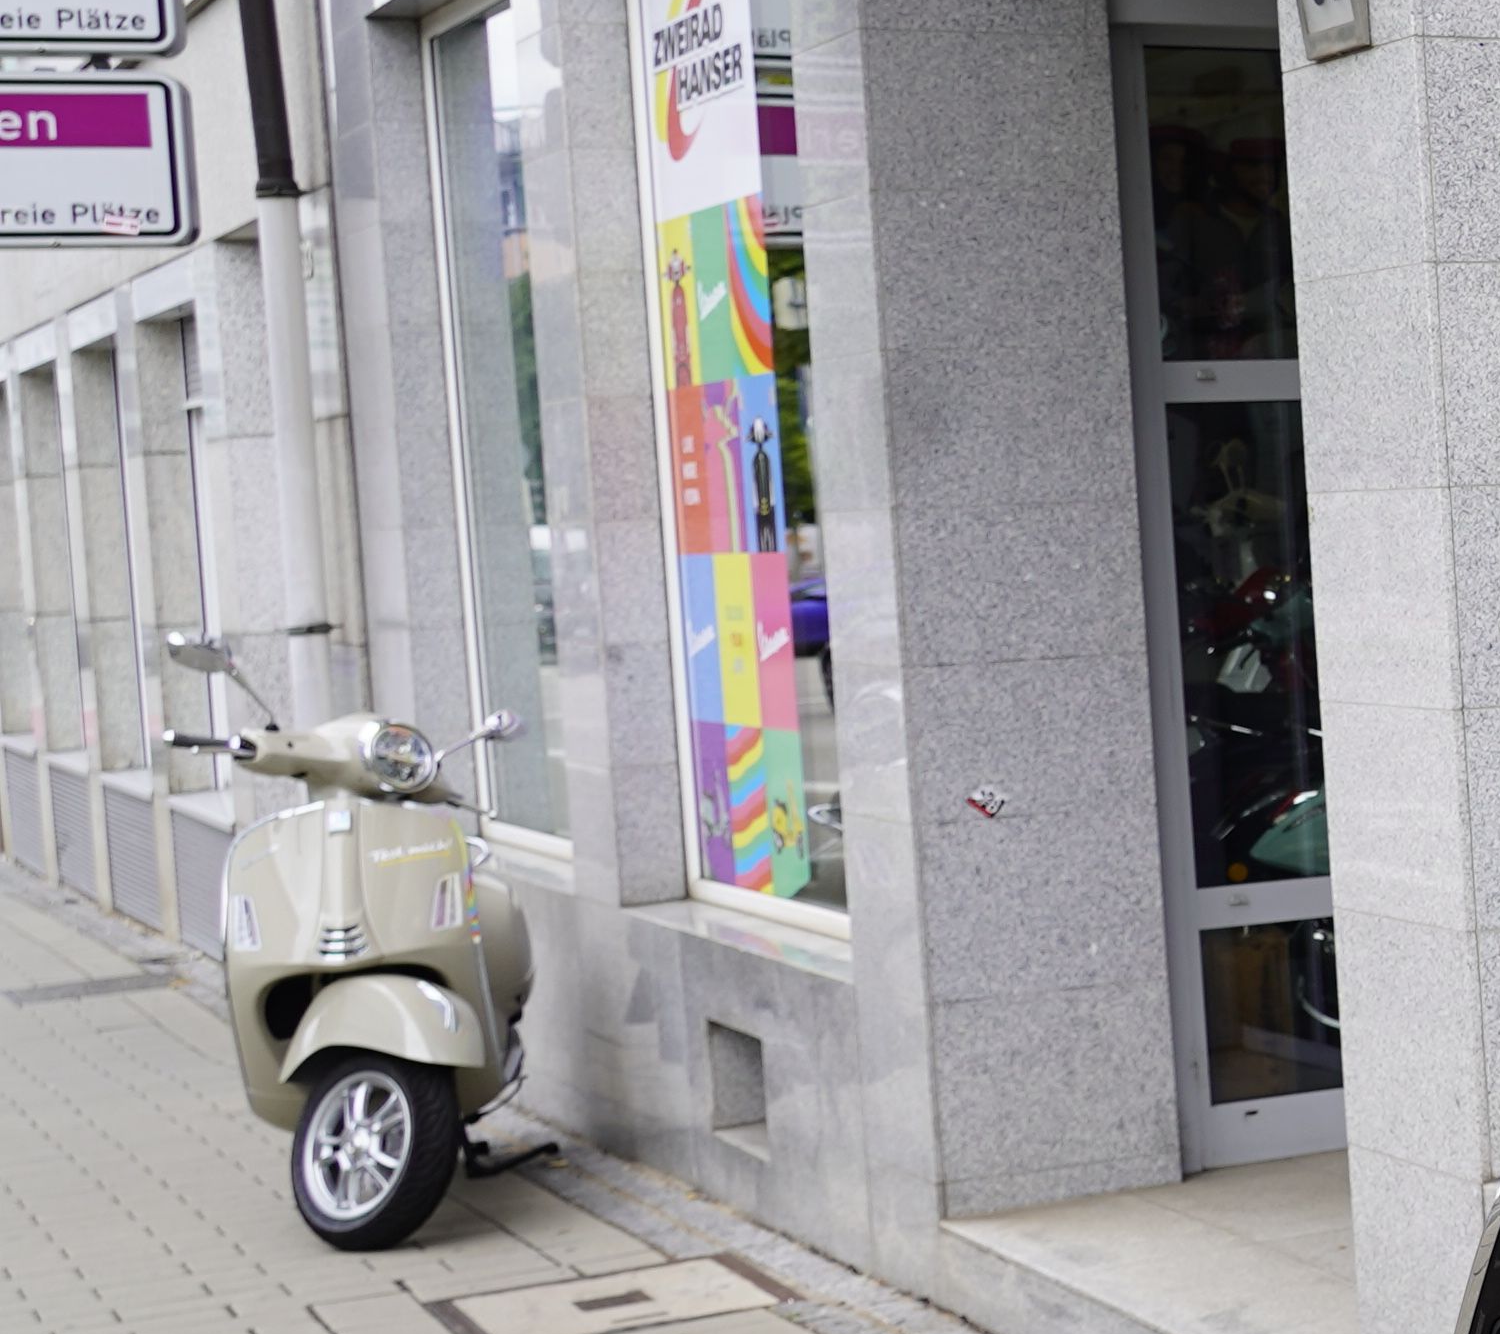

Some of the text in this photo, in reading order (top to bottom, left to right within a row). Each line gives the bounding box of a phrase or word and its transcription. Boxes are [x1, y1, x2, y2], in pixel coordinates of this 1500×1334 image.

[57, 9, 146, 31] Plätze
[653, 3, 724, 66] ZWEIRAD
[678, 43, 743, 104] HANSER
